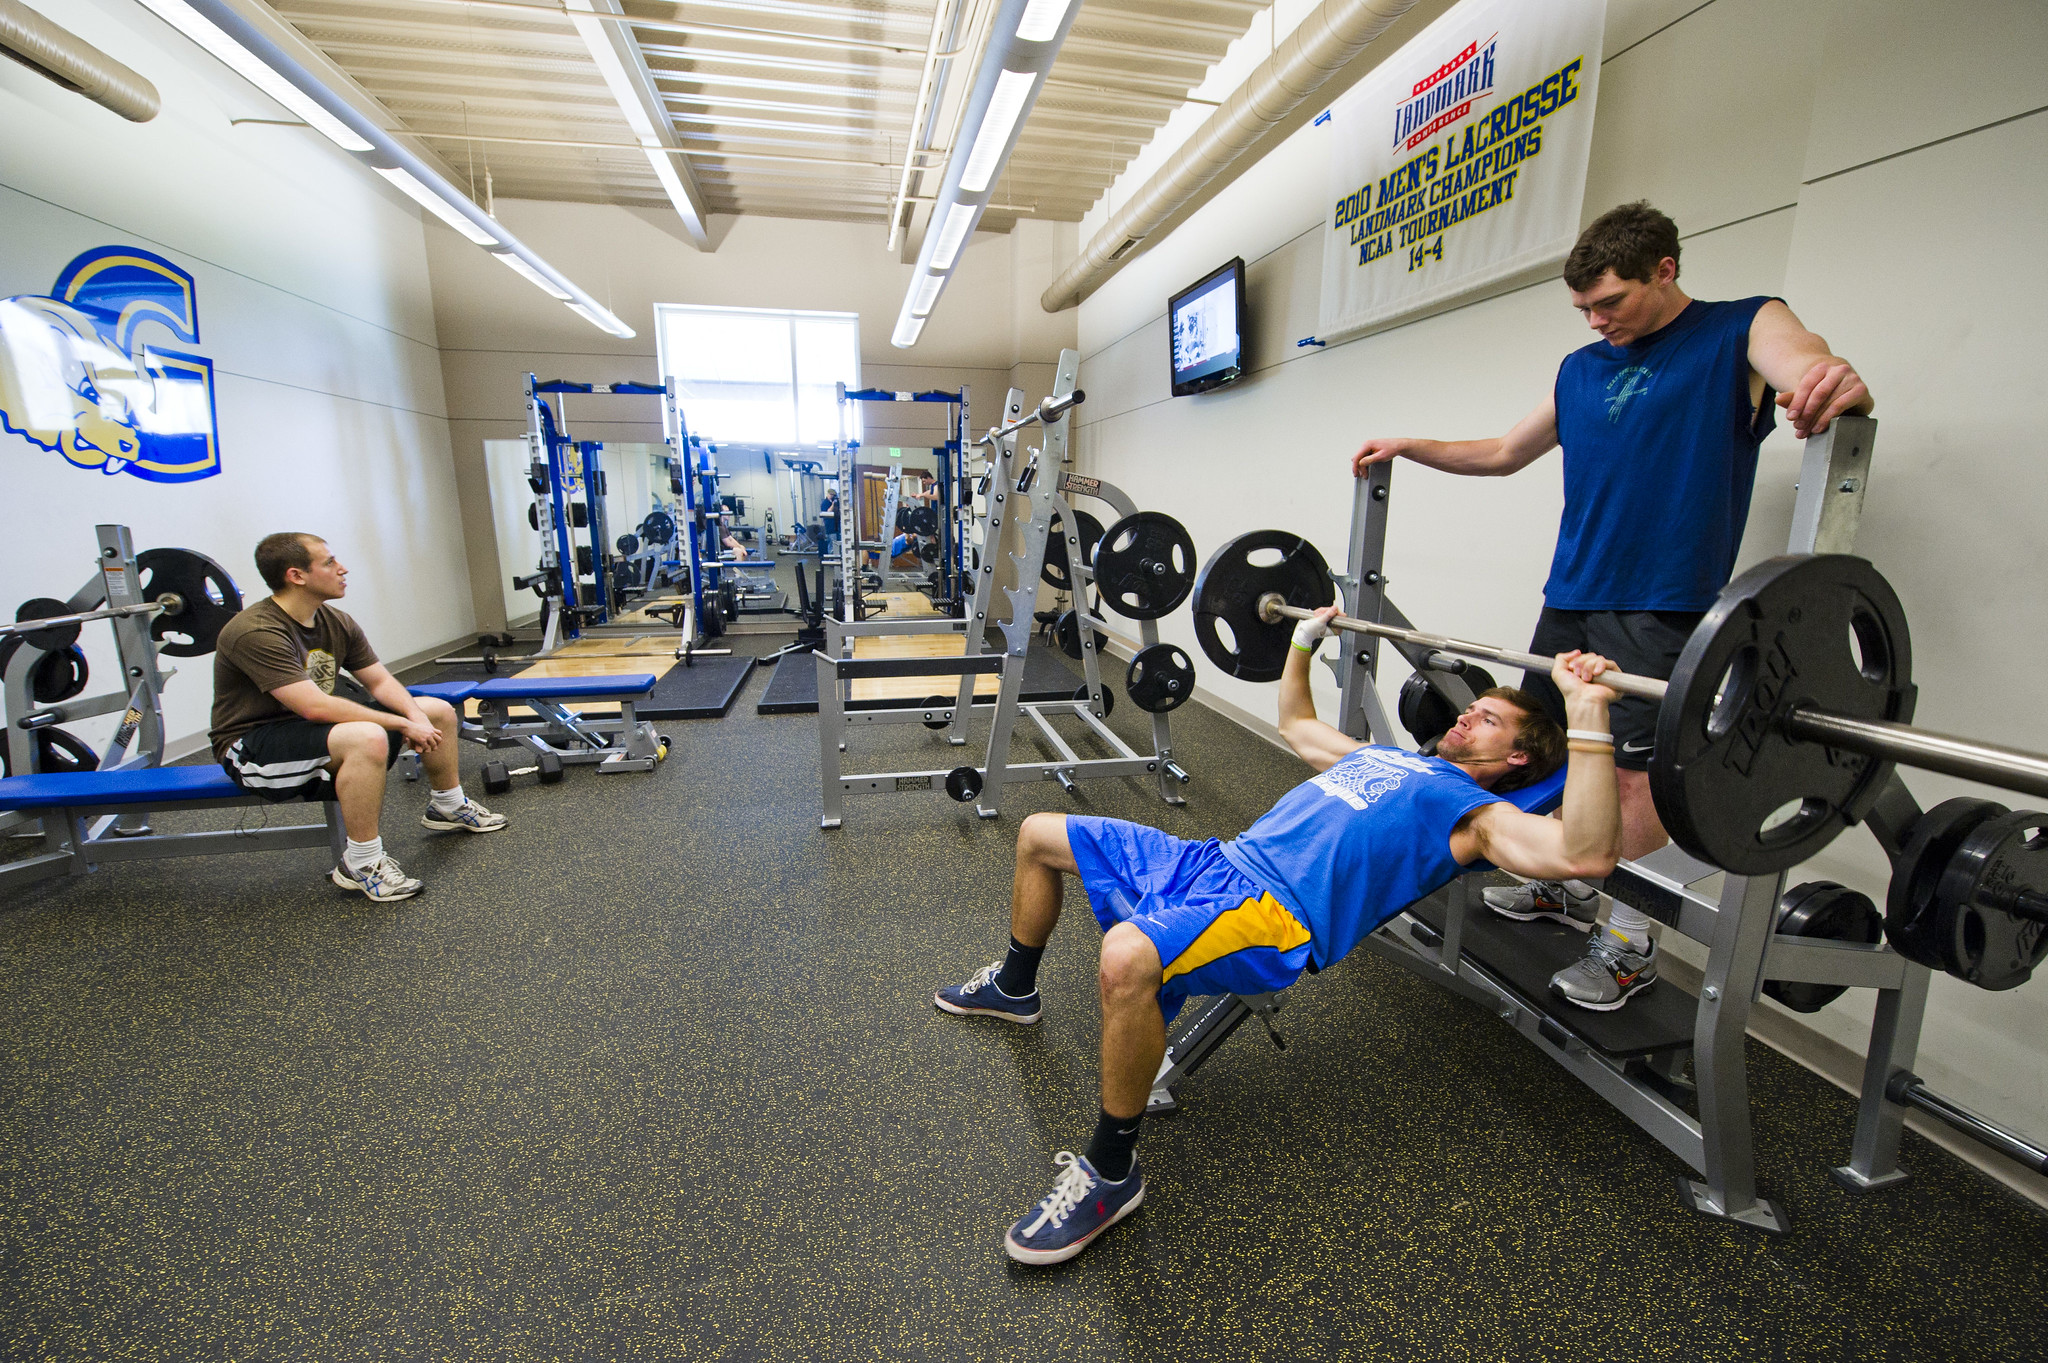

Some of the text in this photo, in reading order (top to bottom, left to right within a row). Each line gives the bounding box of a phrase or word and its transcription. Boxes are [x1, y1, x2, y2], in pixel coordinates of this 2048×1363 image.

[1393, 40, 1497, 148] LANDMARK
[1408, 103, 1469, 147] CONFERENCE
[1334, 56, 1582, 230] 2010 MEN'S LACROSSE
[1350, 124, 1543, 246] LANDMARK CHAMPIONS
[1359, 168, 1519, 266] NCAA TOURNAMENT
[1408, 234, 1443, 272] 14-4
[1065, 482, 1099, 496] STRENGTH
[1069, 474, 1099, 487] HAMMER
